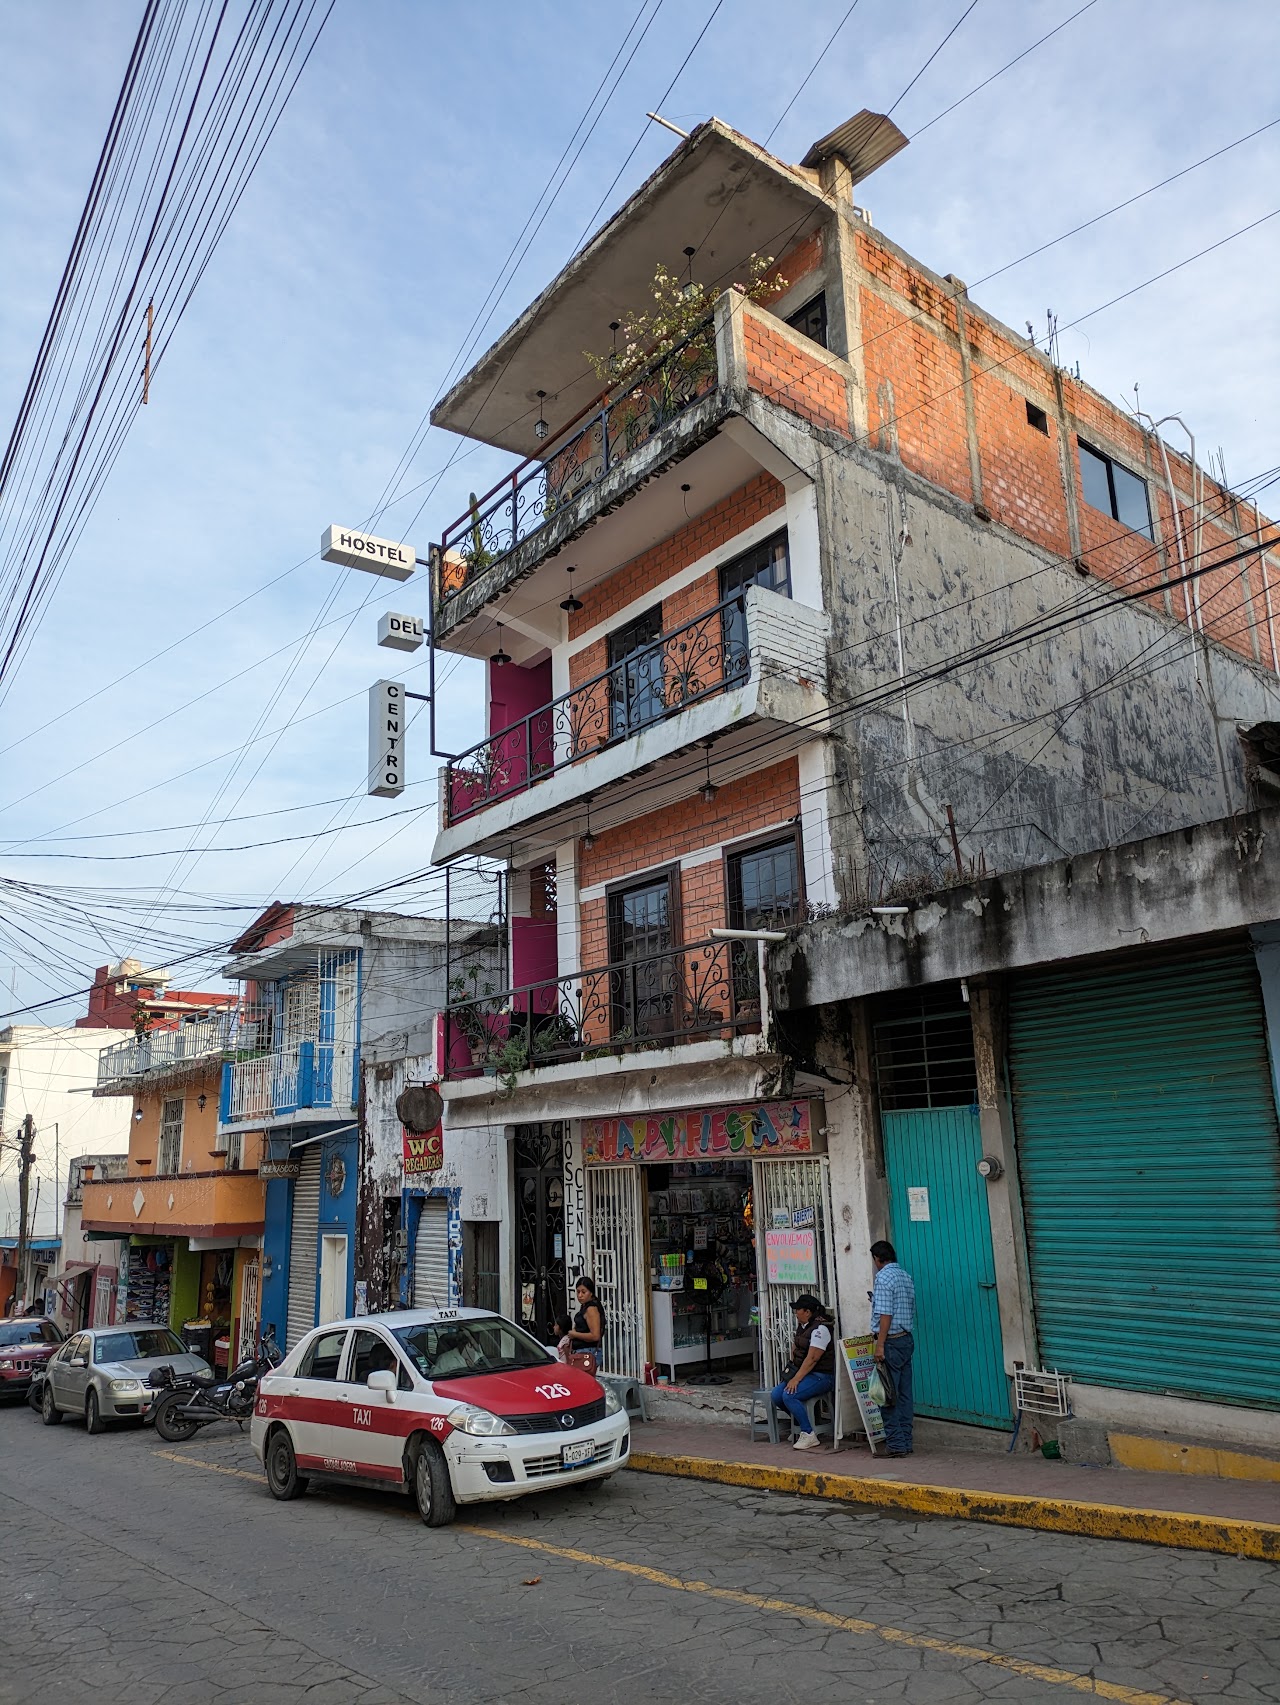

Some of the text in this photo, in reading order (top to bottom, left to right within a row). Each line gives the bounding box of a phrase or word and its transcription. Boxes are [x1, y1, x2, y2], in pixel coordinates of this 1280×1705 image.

[340, 533, 408, 564] HOSTEL
[389, 618, 422, 636] DEL
[385, 686, 399, 785] CENTRO
[602, 1115, 675, 1162] HAPPY
[686, 1106, 779, 1157] FIESTA
[407, 1136, 440, 1156] WC
[405, 1154, 443, 1173] REGADERAS
[564, 1120, 575, 1247] HOSTEL
[575, 1168, 585, 1276] CENTR
[793, 1208, 813, 1224] ABIERTO
[766, 1232, 813, 1246] ENVOLVEMOS
[568, 1266, 576, 1317] DE
[438, 1310, 457, 1318] TAXI
[535, 1383, 571, 1400] 126
[258, 1398, 267, 1413] 126
[352, 1408, 372, 1426] TAXI
[430, 1416, 445, 1431] 126
